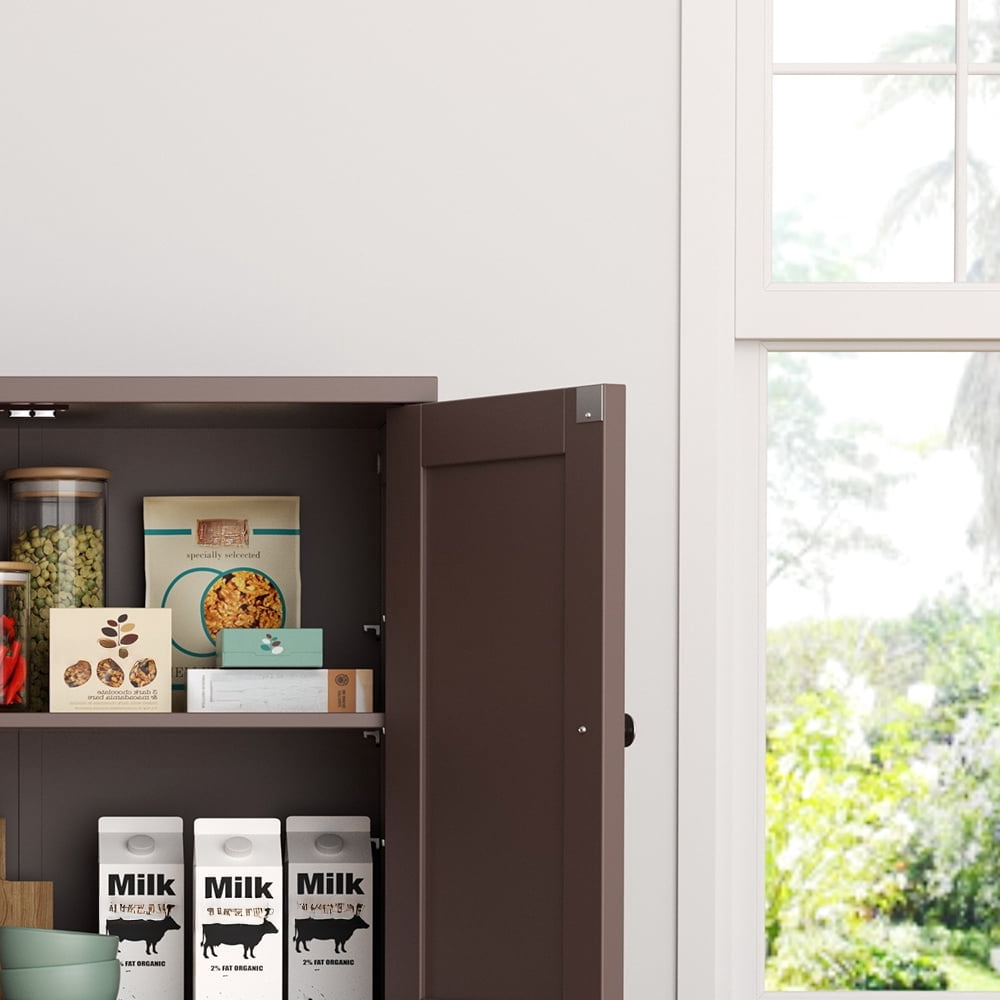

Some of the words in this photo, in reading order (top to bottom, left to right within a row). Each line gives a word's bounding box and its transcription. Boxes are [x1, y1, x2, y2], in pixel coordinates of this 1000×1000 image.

[186, 550, 221, 561] specially
[108, 873, 176, 896] Milk
[204, 876, 274, 899] Milk
[297, 872, 365, 895] Milk
[210, 964, 221, 972] 2%
[222, 964, 233, 972] FAT
[233, 964, 264, 972] ORGANIC
